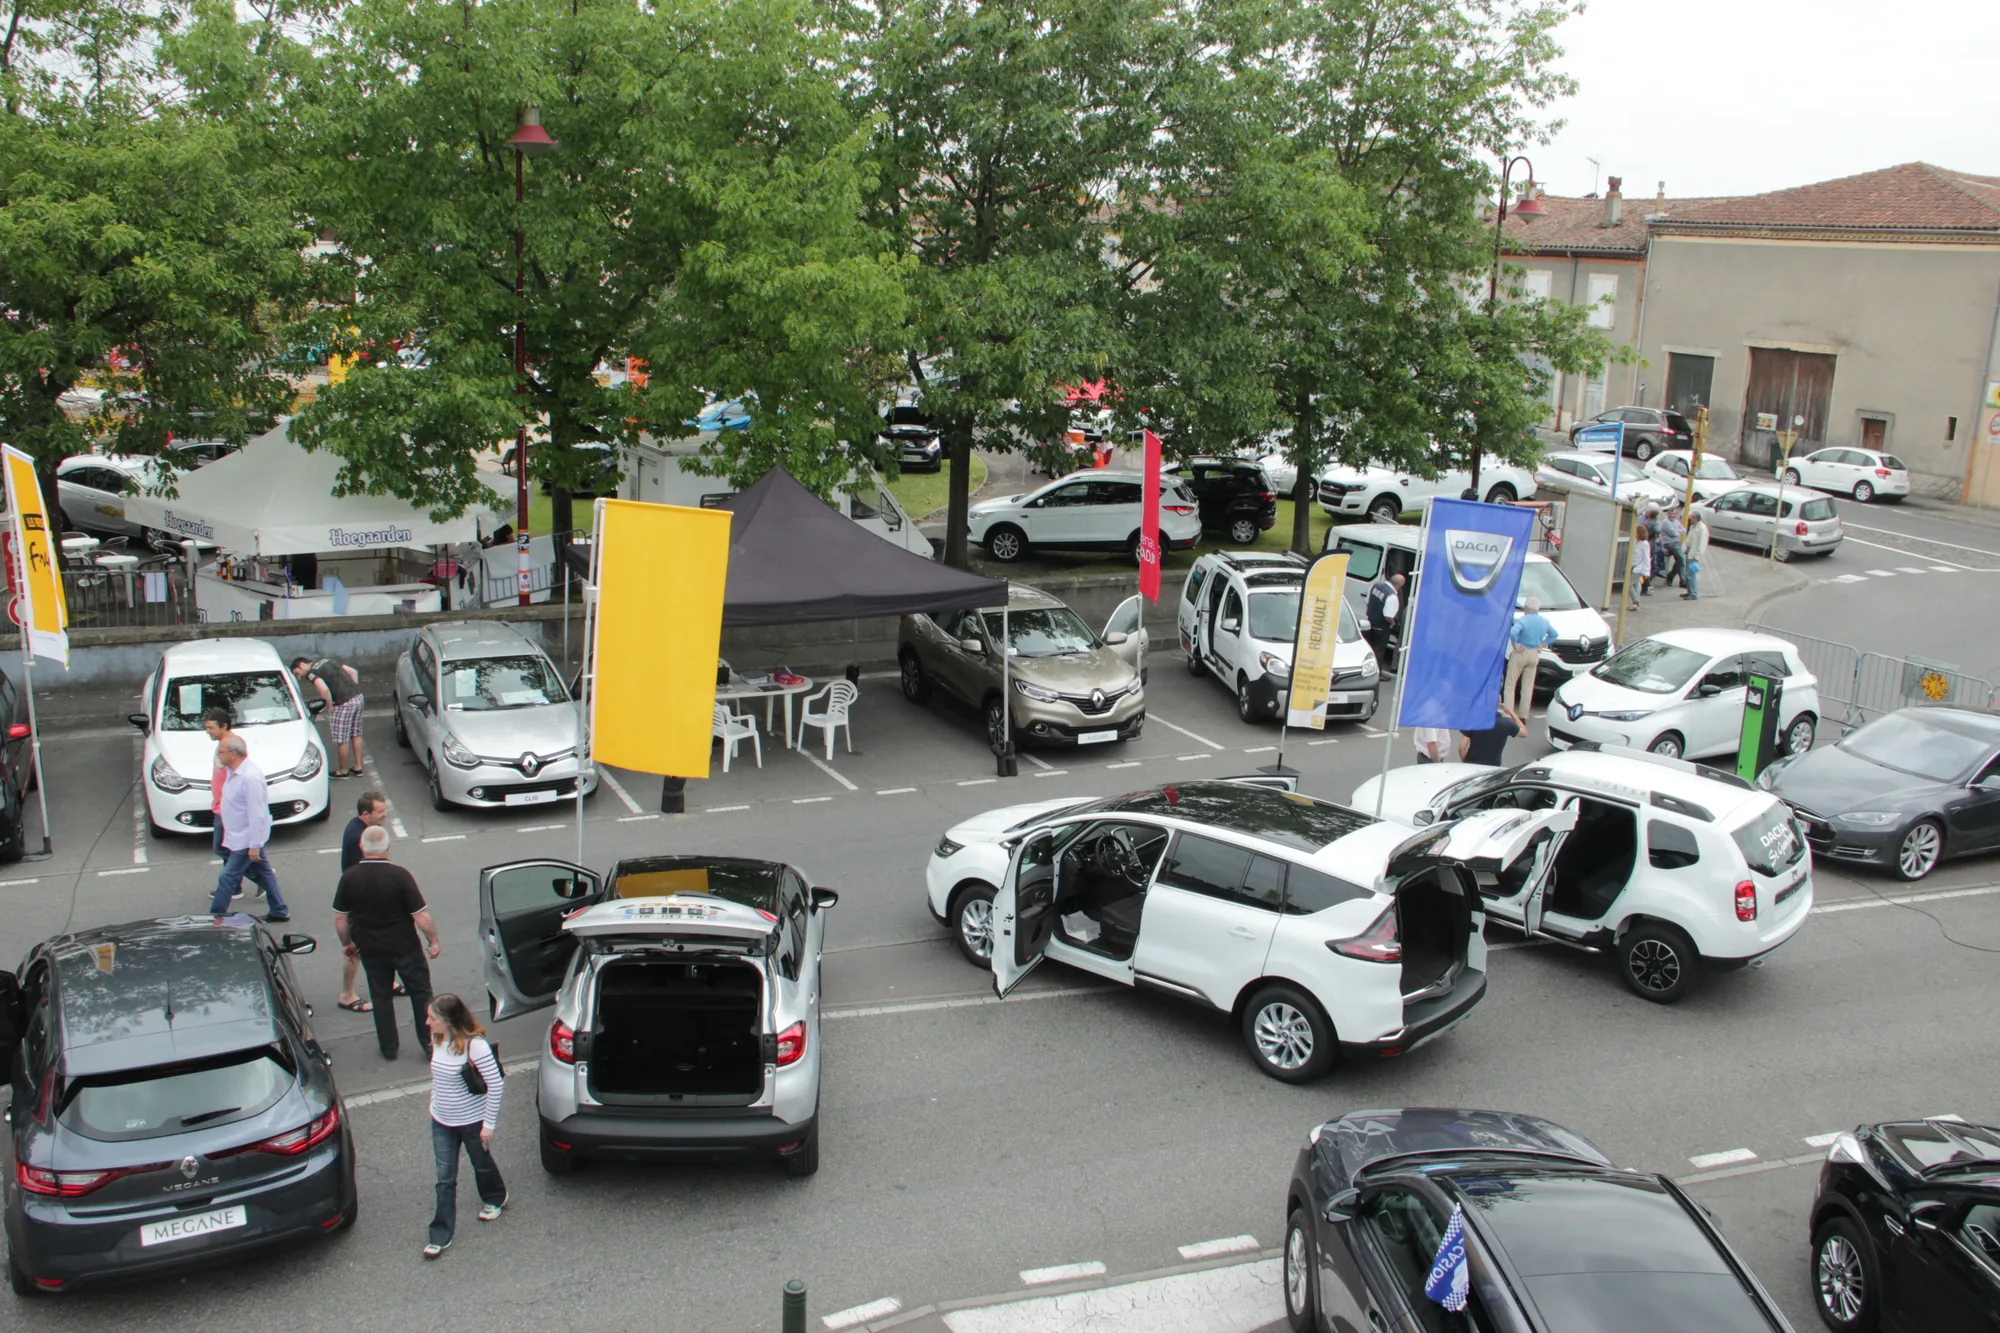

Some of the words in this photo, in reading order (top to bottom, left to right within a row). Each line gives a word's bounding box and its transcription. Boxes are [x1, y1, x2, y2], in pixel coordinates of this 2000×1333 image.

[164, 510, 213, 540] Hoegaarden
[329, 525, 412, 547] Hoegaarden
[1455, 540, 1499, 553] DACIA
[1309, 596, 1328, 650] RENAULT
[1760, 823, 1788, 847] DACIA
[162, 1177, 220, 1192] MEGANE
[154, 1211, 235, 1240] MEGANE
